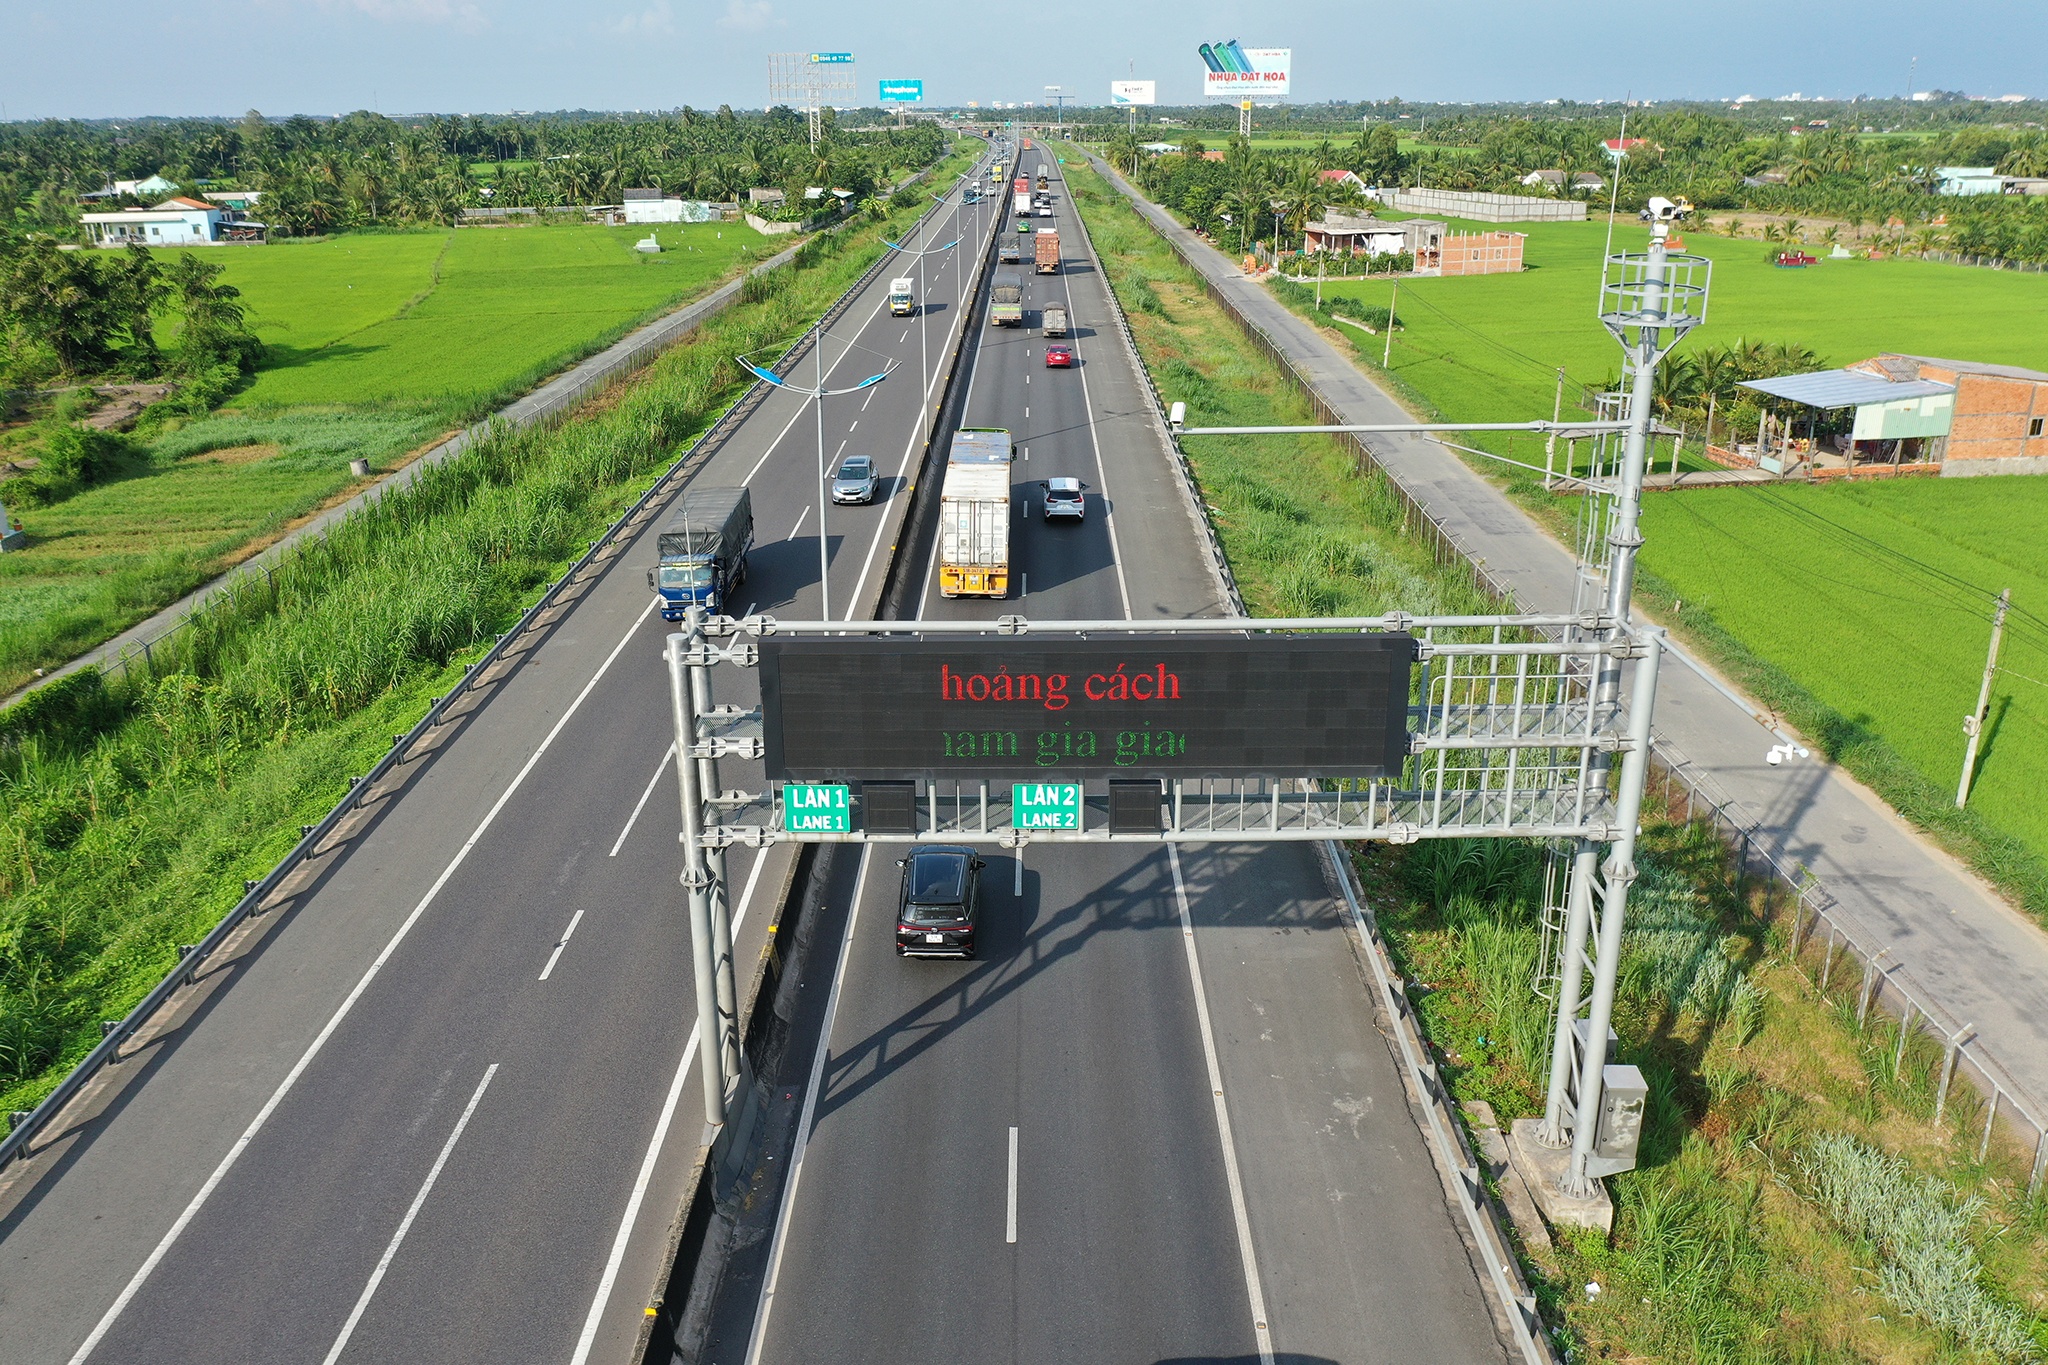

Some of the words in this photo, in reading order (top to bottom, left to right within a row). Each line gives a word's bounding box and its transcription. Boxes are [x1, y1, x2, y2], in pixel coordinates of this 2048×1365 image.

[942, 663, 1070, 711] hoảng
[1084, 662, 1182, 701] cách
[1035, 720, 1099, 767] gia
[1113, 720, 1187, 767] gia
[835, 788, 846, 808] 1
[1062, 786, 1076, 806] 2
[793, 815, 832, 830] LANE
[835, 815, 845, 830] 1
[1022, 812, 1062, 827] LANE
[1064, 812, 1076, 827] 2
